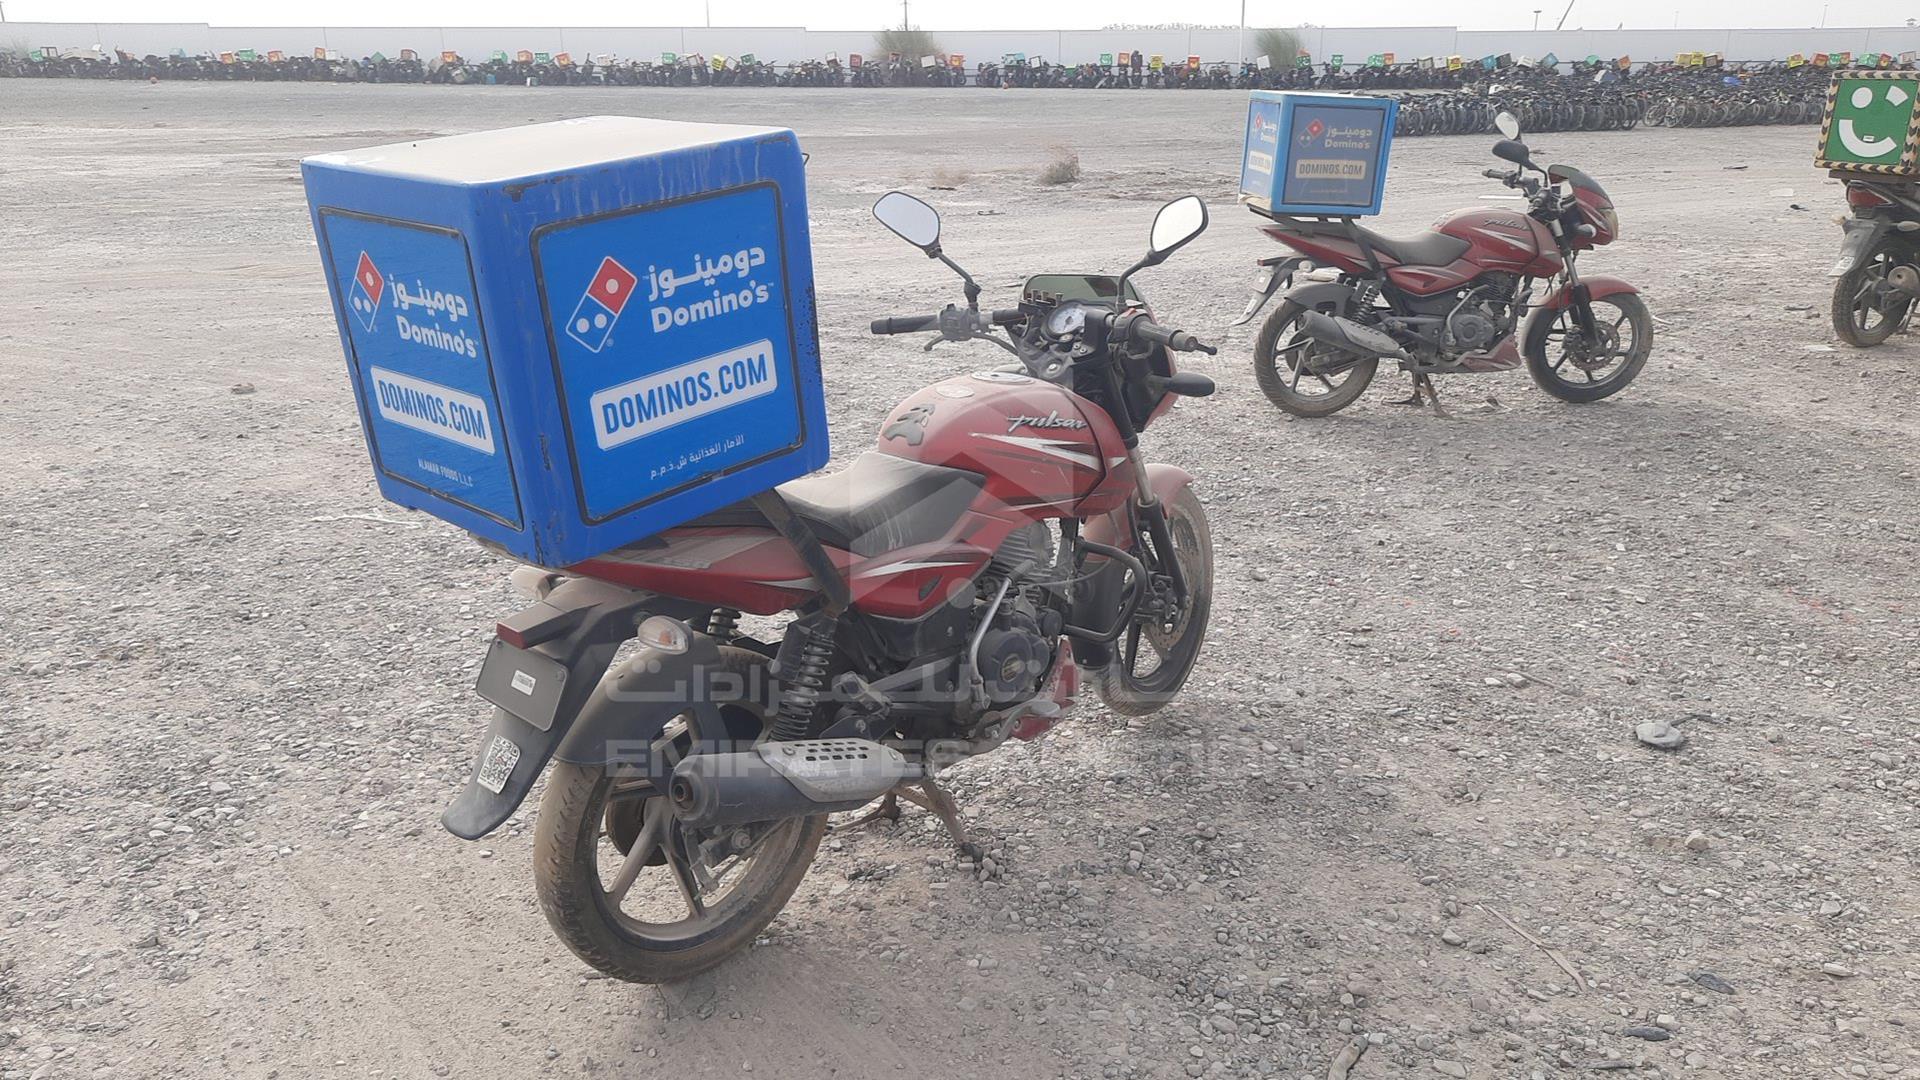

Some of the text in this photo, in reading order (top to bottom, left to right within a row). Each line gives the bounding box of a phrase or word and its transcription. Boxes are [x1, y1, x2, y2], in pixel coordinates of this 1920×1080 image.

[1299, 163, 1363, 175] DOMINOS.COM
[389, 273, 469, 323] دومينوز
[648, 246, 766, 303] دومينوز
[650, 279, 770, 334] Domino's
[396, 314, 477, 359] Domino's
[378, 380, 487, 440] DOMINOS.COM
[602, 353, 768, 435] DOMINOS.COM
